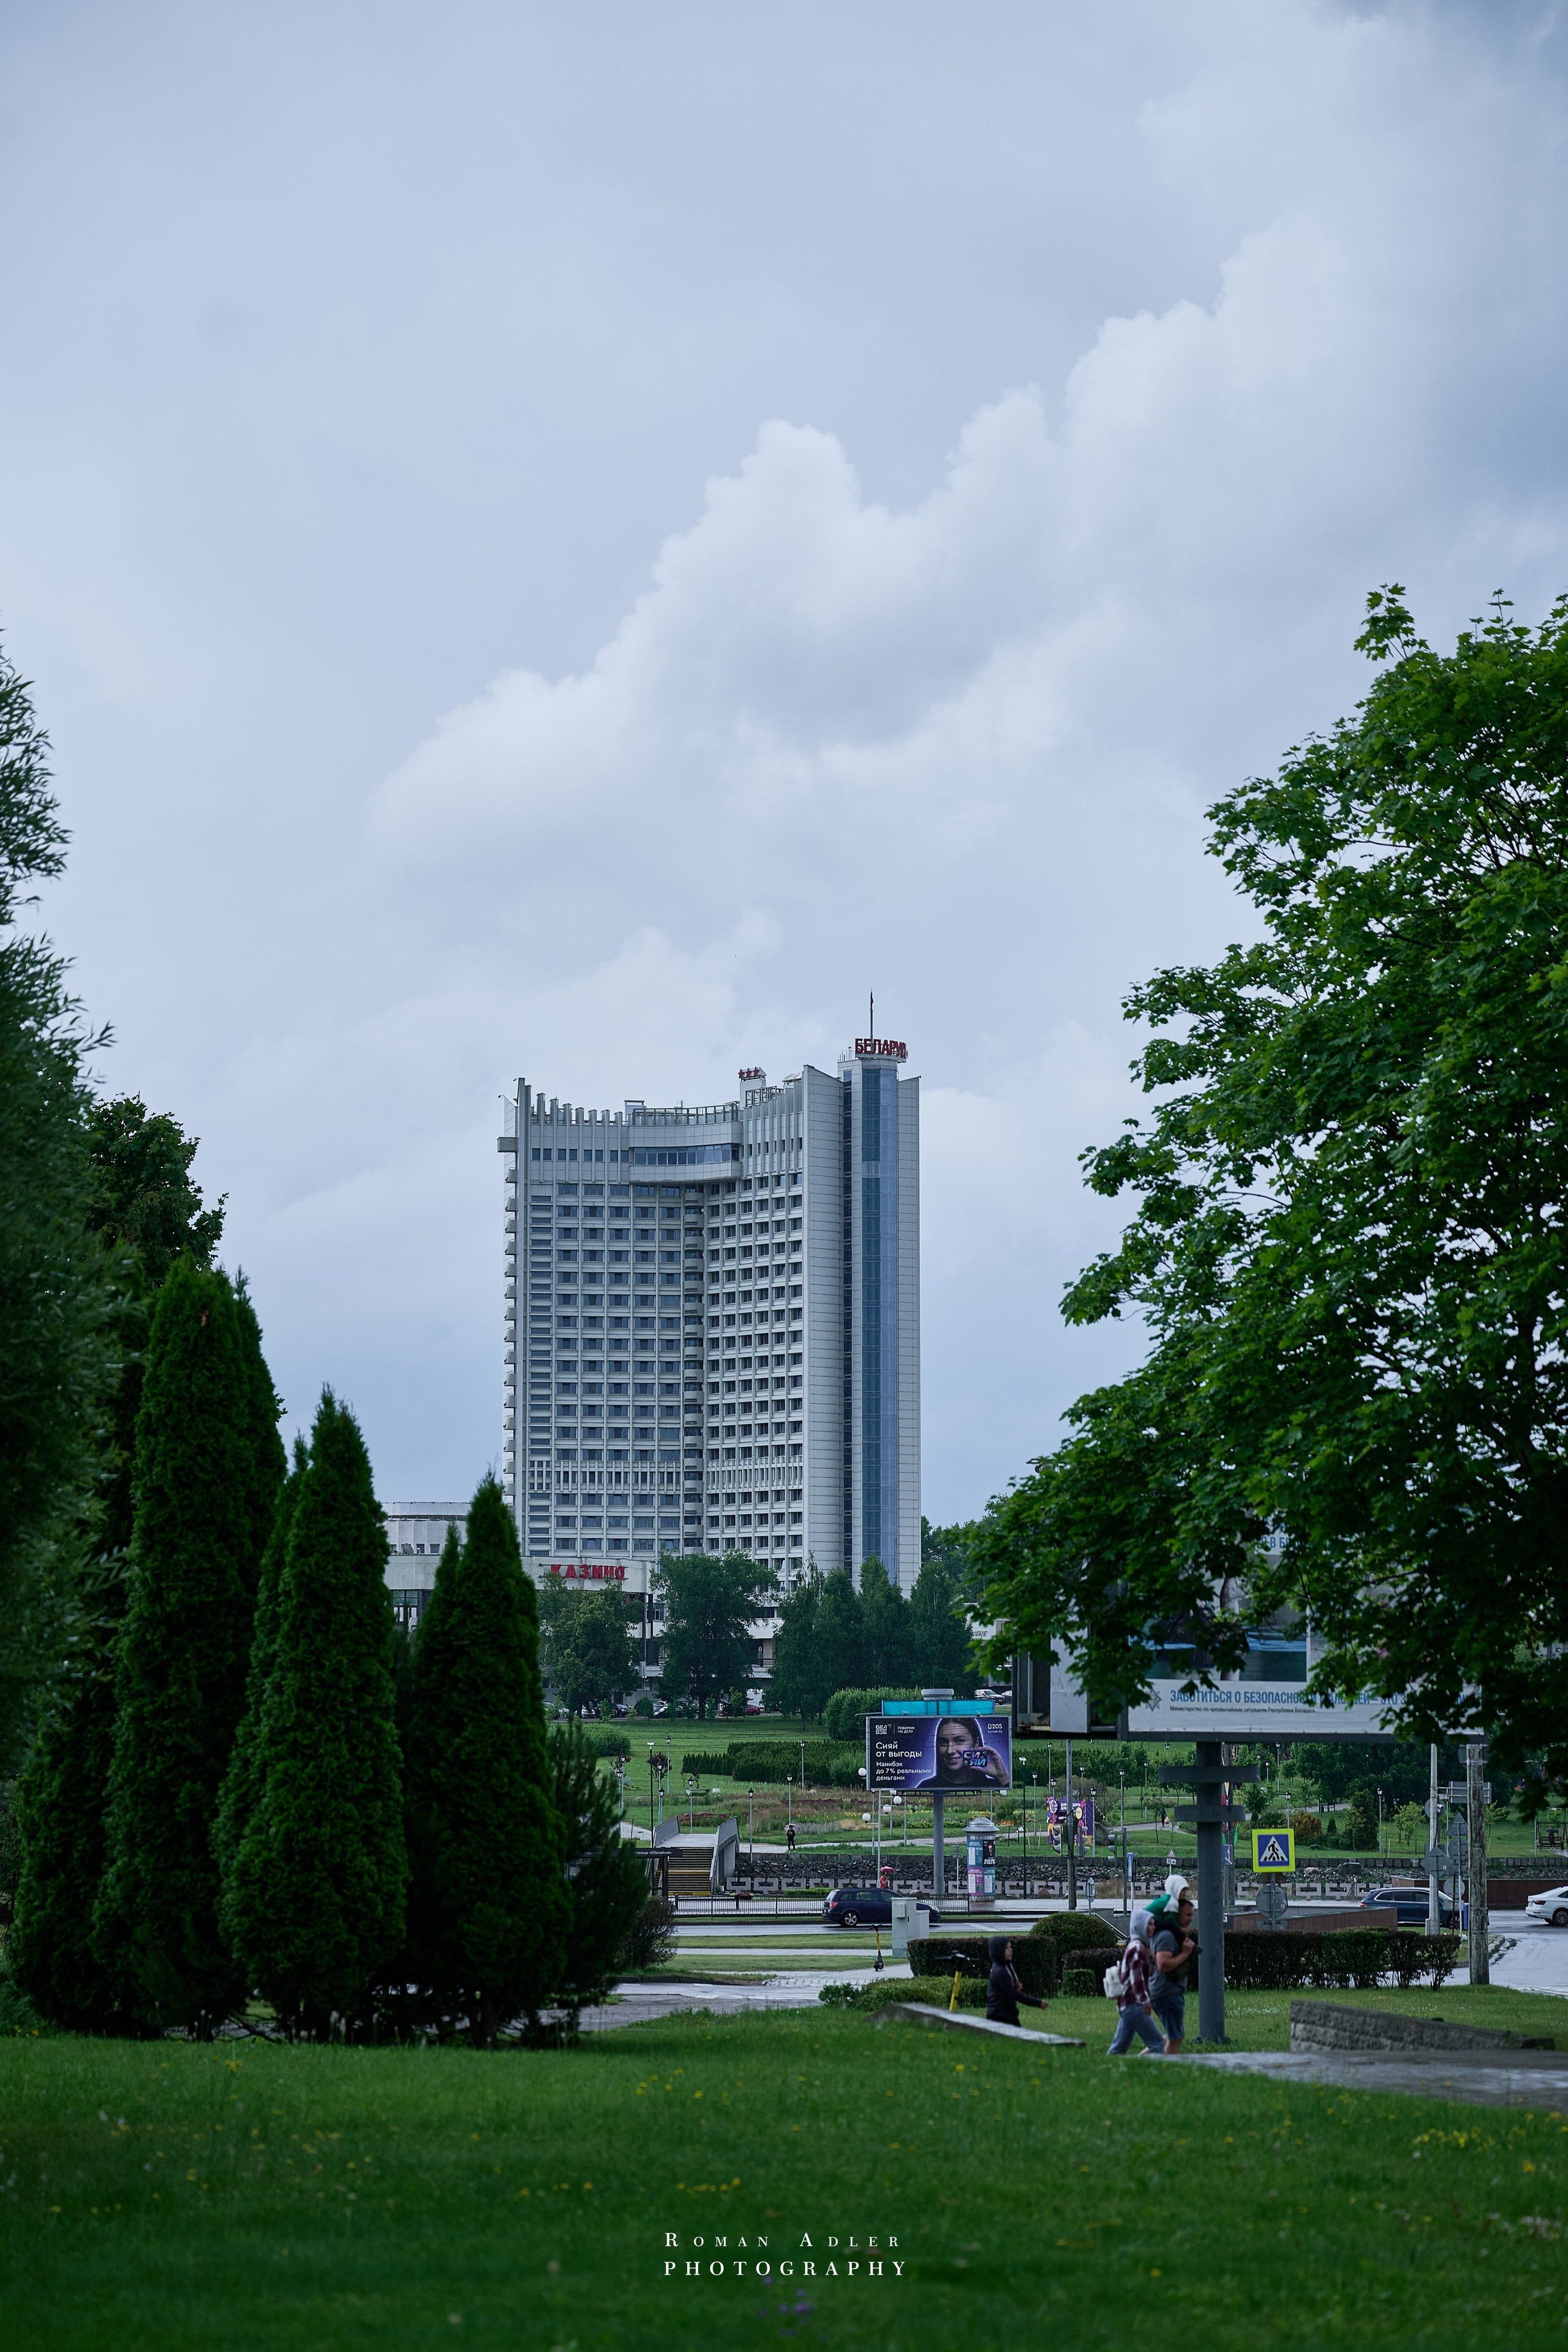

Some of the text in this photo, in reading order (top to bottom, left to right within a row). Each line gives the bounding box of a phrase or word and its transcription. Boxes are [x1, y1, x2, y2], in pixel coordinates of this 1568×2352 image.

[551, 1564, 625, 1580] КАЗИНО
[1235, 1691, 1241, 1703] О
[1244, 1691, 1317, 1705] БЕЗОПАСНОСИ
[876, 1741, 898, 1749] Сияй
